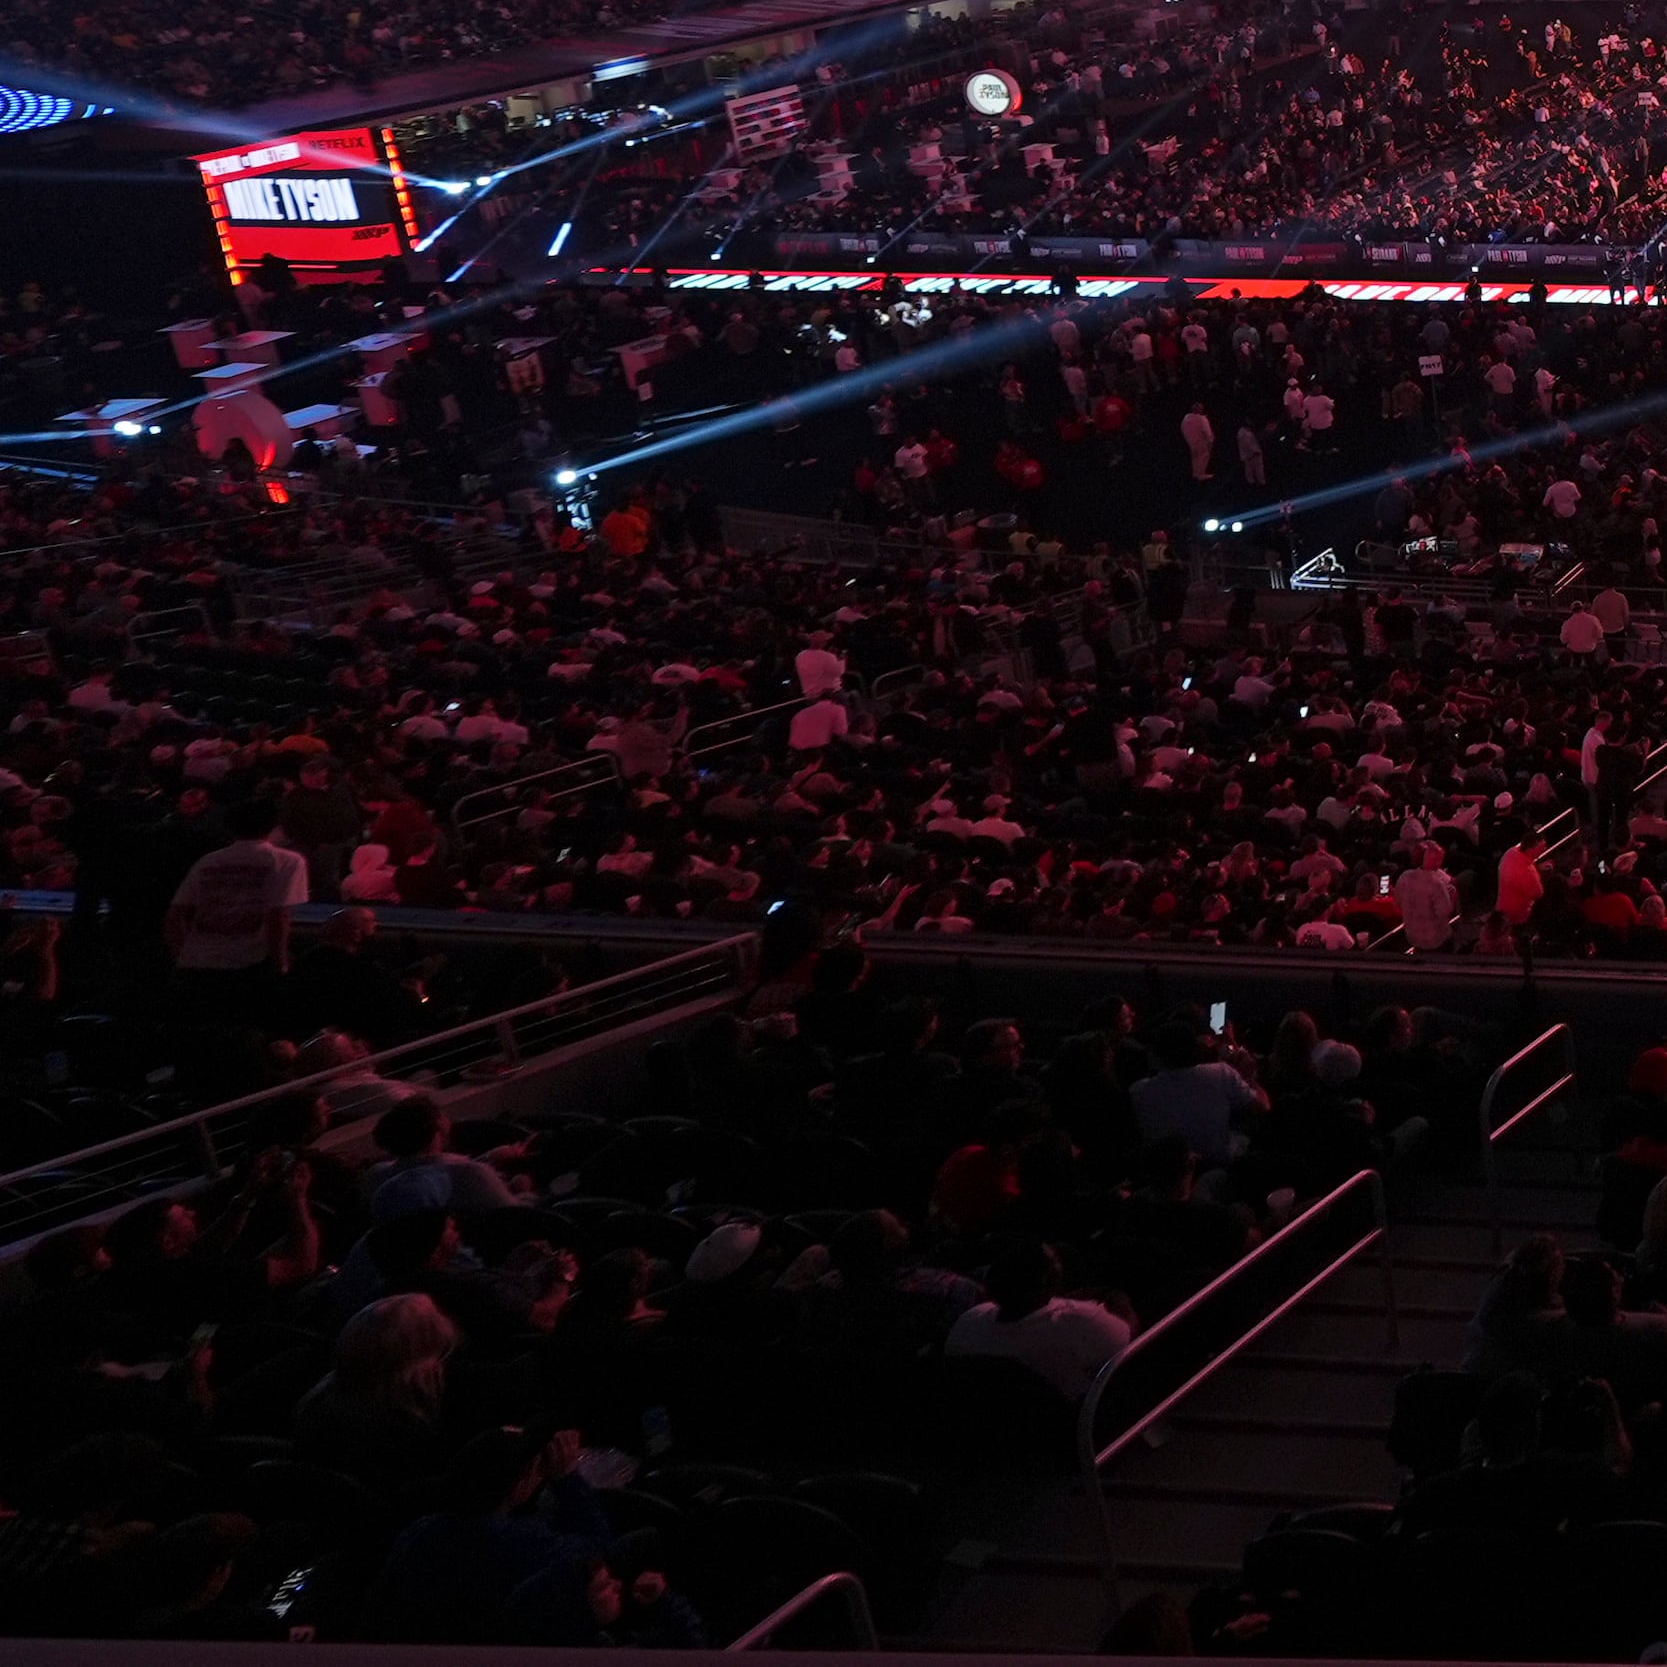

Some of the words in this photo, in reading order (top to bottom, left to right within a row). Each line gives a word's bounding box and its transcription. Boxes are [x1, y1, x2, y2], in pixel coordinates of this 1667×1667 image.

[309, 137, 366, 150] NETFLIX
[223, 179, 284, 220] MIKE
[276, 178, 360, 221] TYSON
